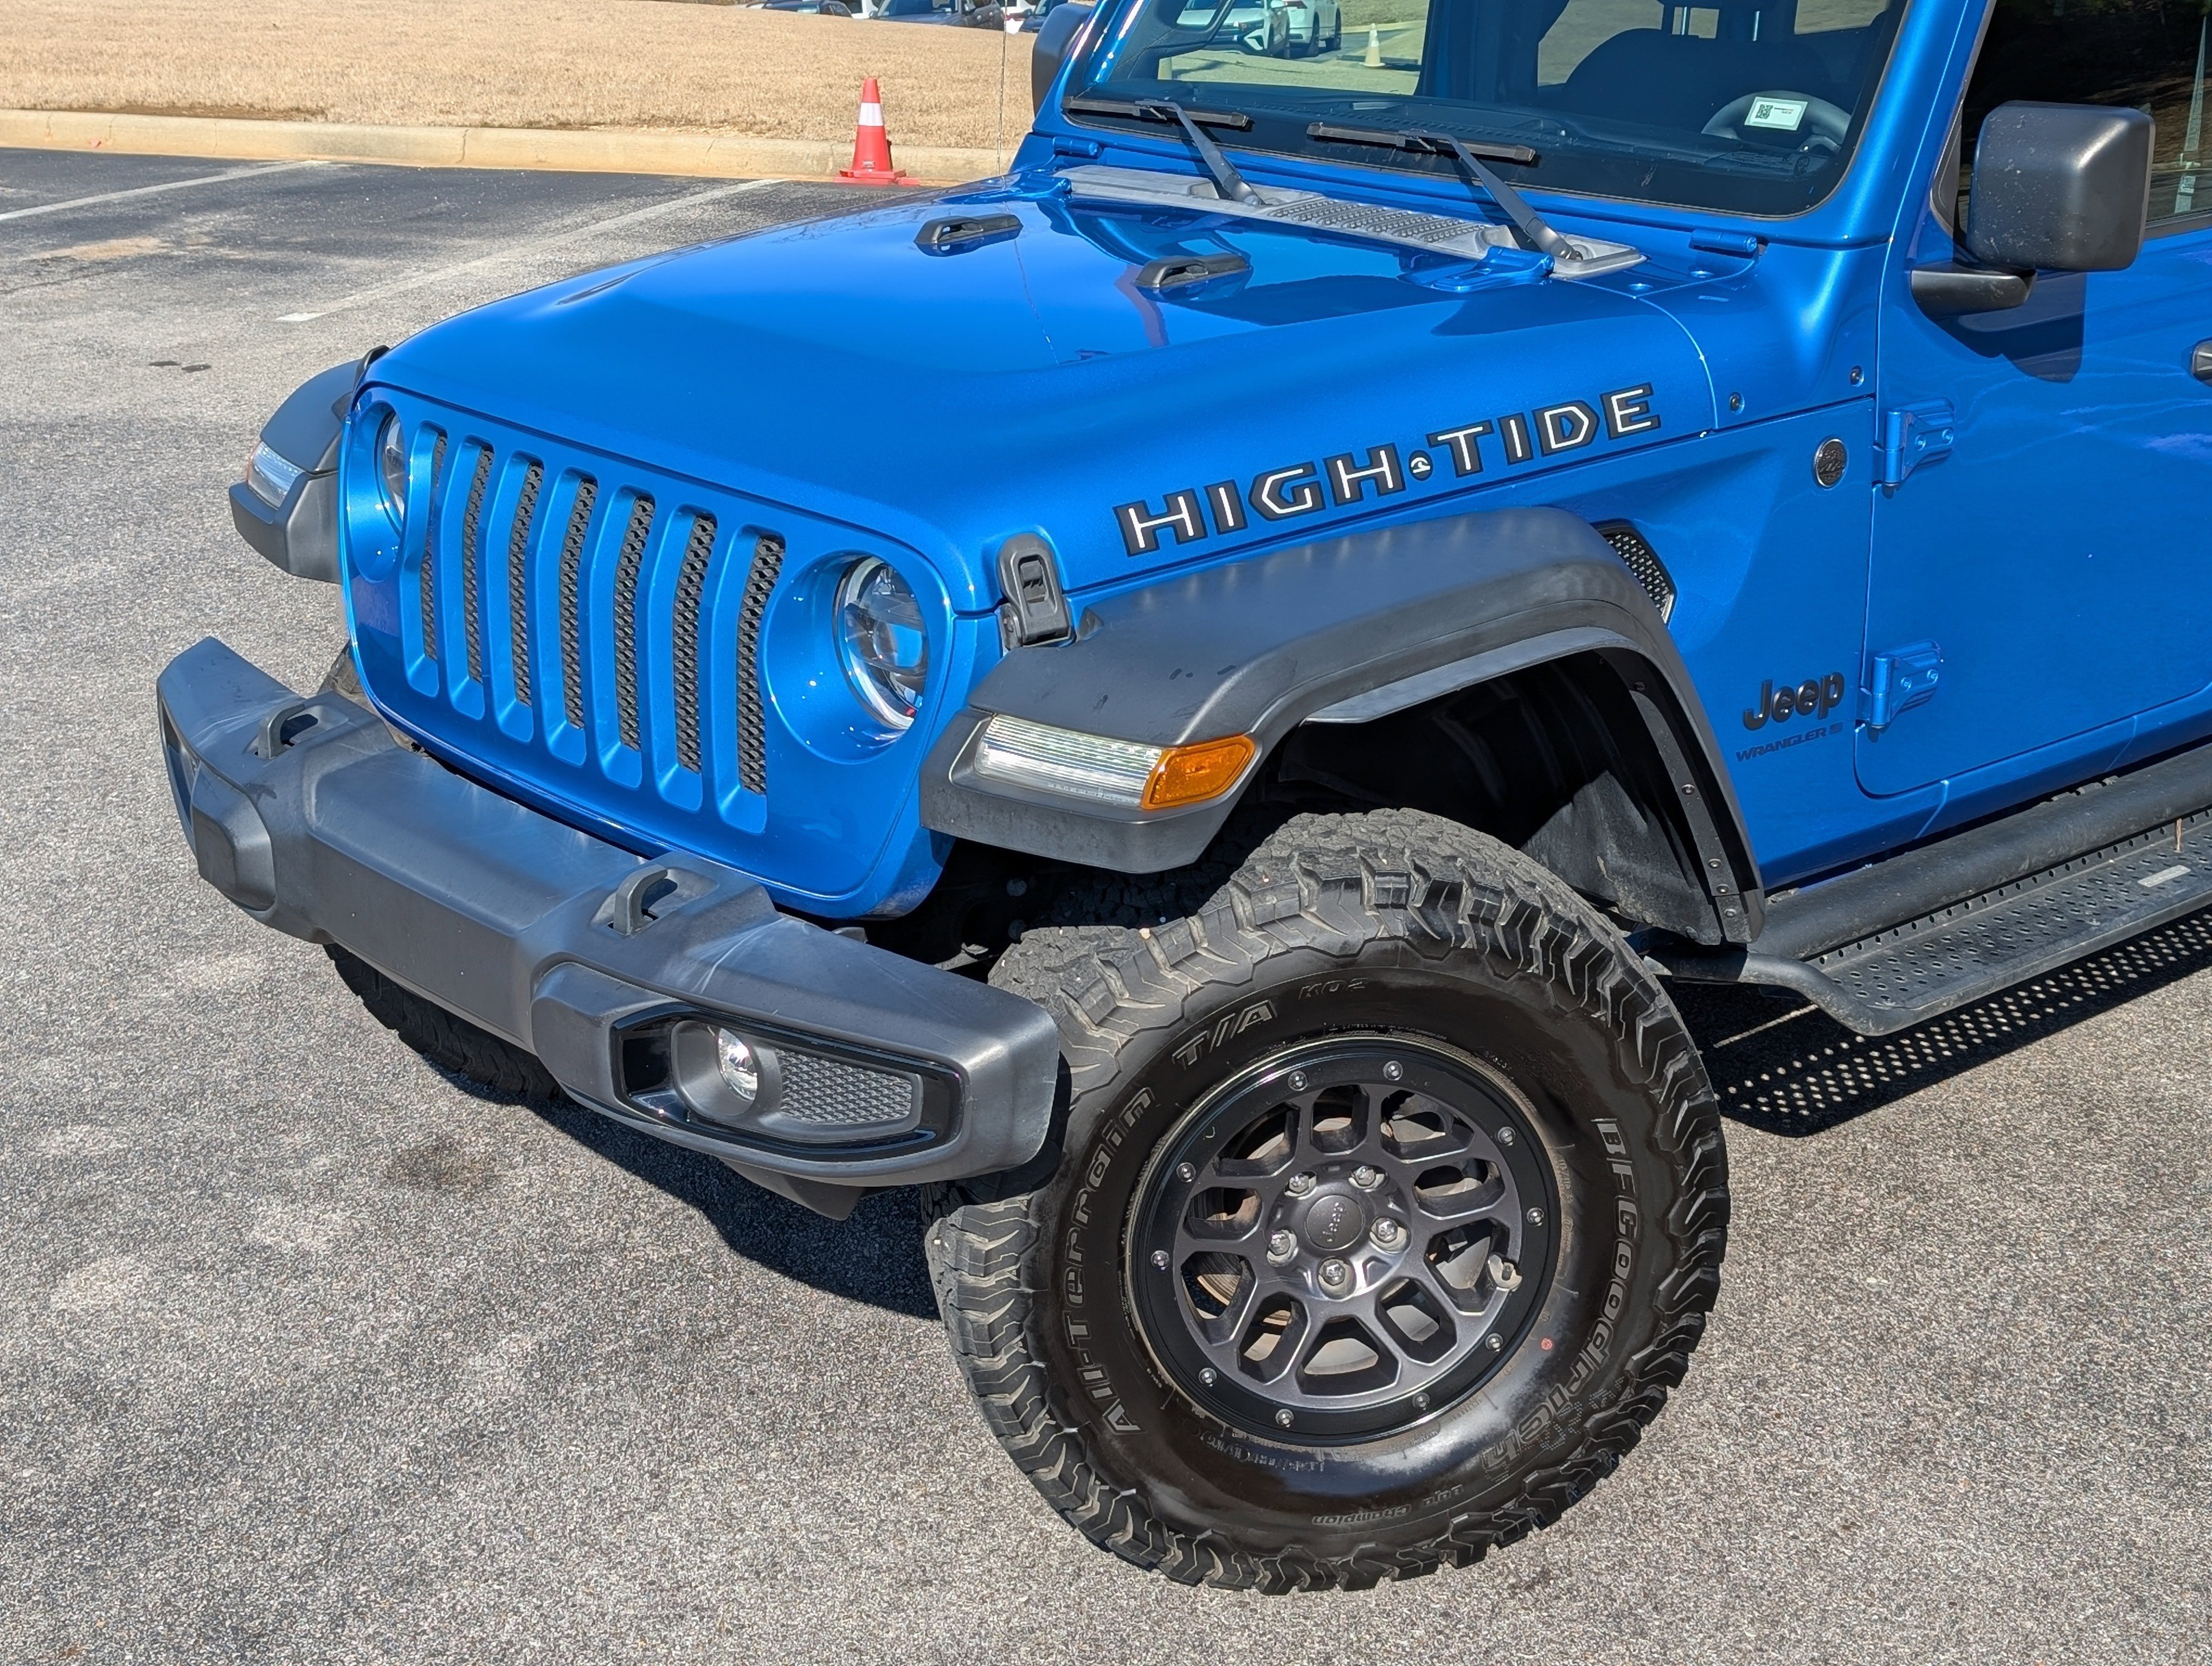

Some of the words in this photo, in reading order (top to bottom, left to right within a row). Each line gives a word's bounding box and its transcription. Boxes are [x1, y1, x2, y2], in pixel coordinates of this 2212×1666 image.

[1113, 442, 1406, 558] HIGH
[1429, 381, 1661, 478] TIDE
[1735, 727, 1827, 762] WRANGLER
[1743, 671, 1845, 731] Jeep
[1063, 1086, 1156, 1434] All-Terrain
[1172, 999, 1278, 1071] T/A
[1298, 977, 1368, 1001] KO2
[1481, 1117, 1642, 1472] BFGoodrich
